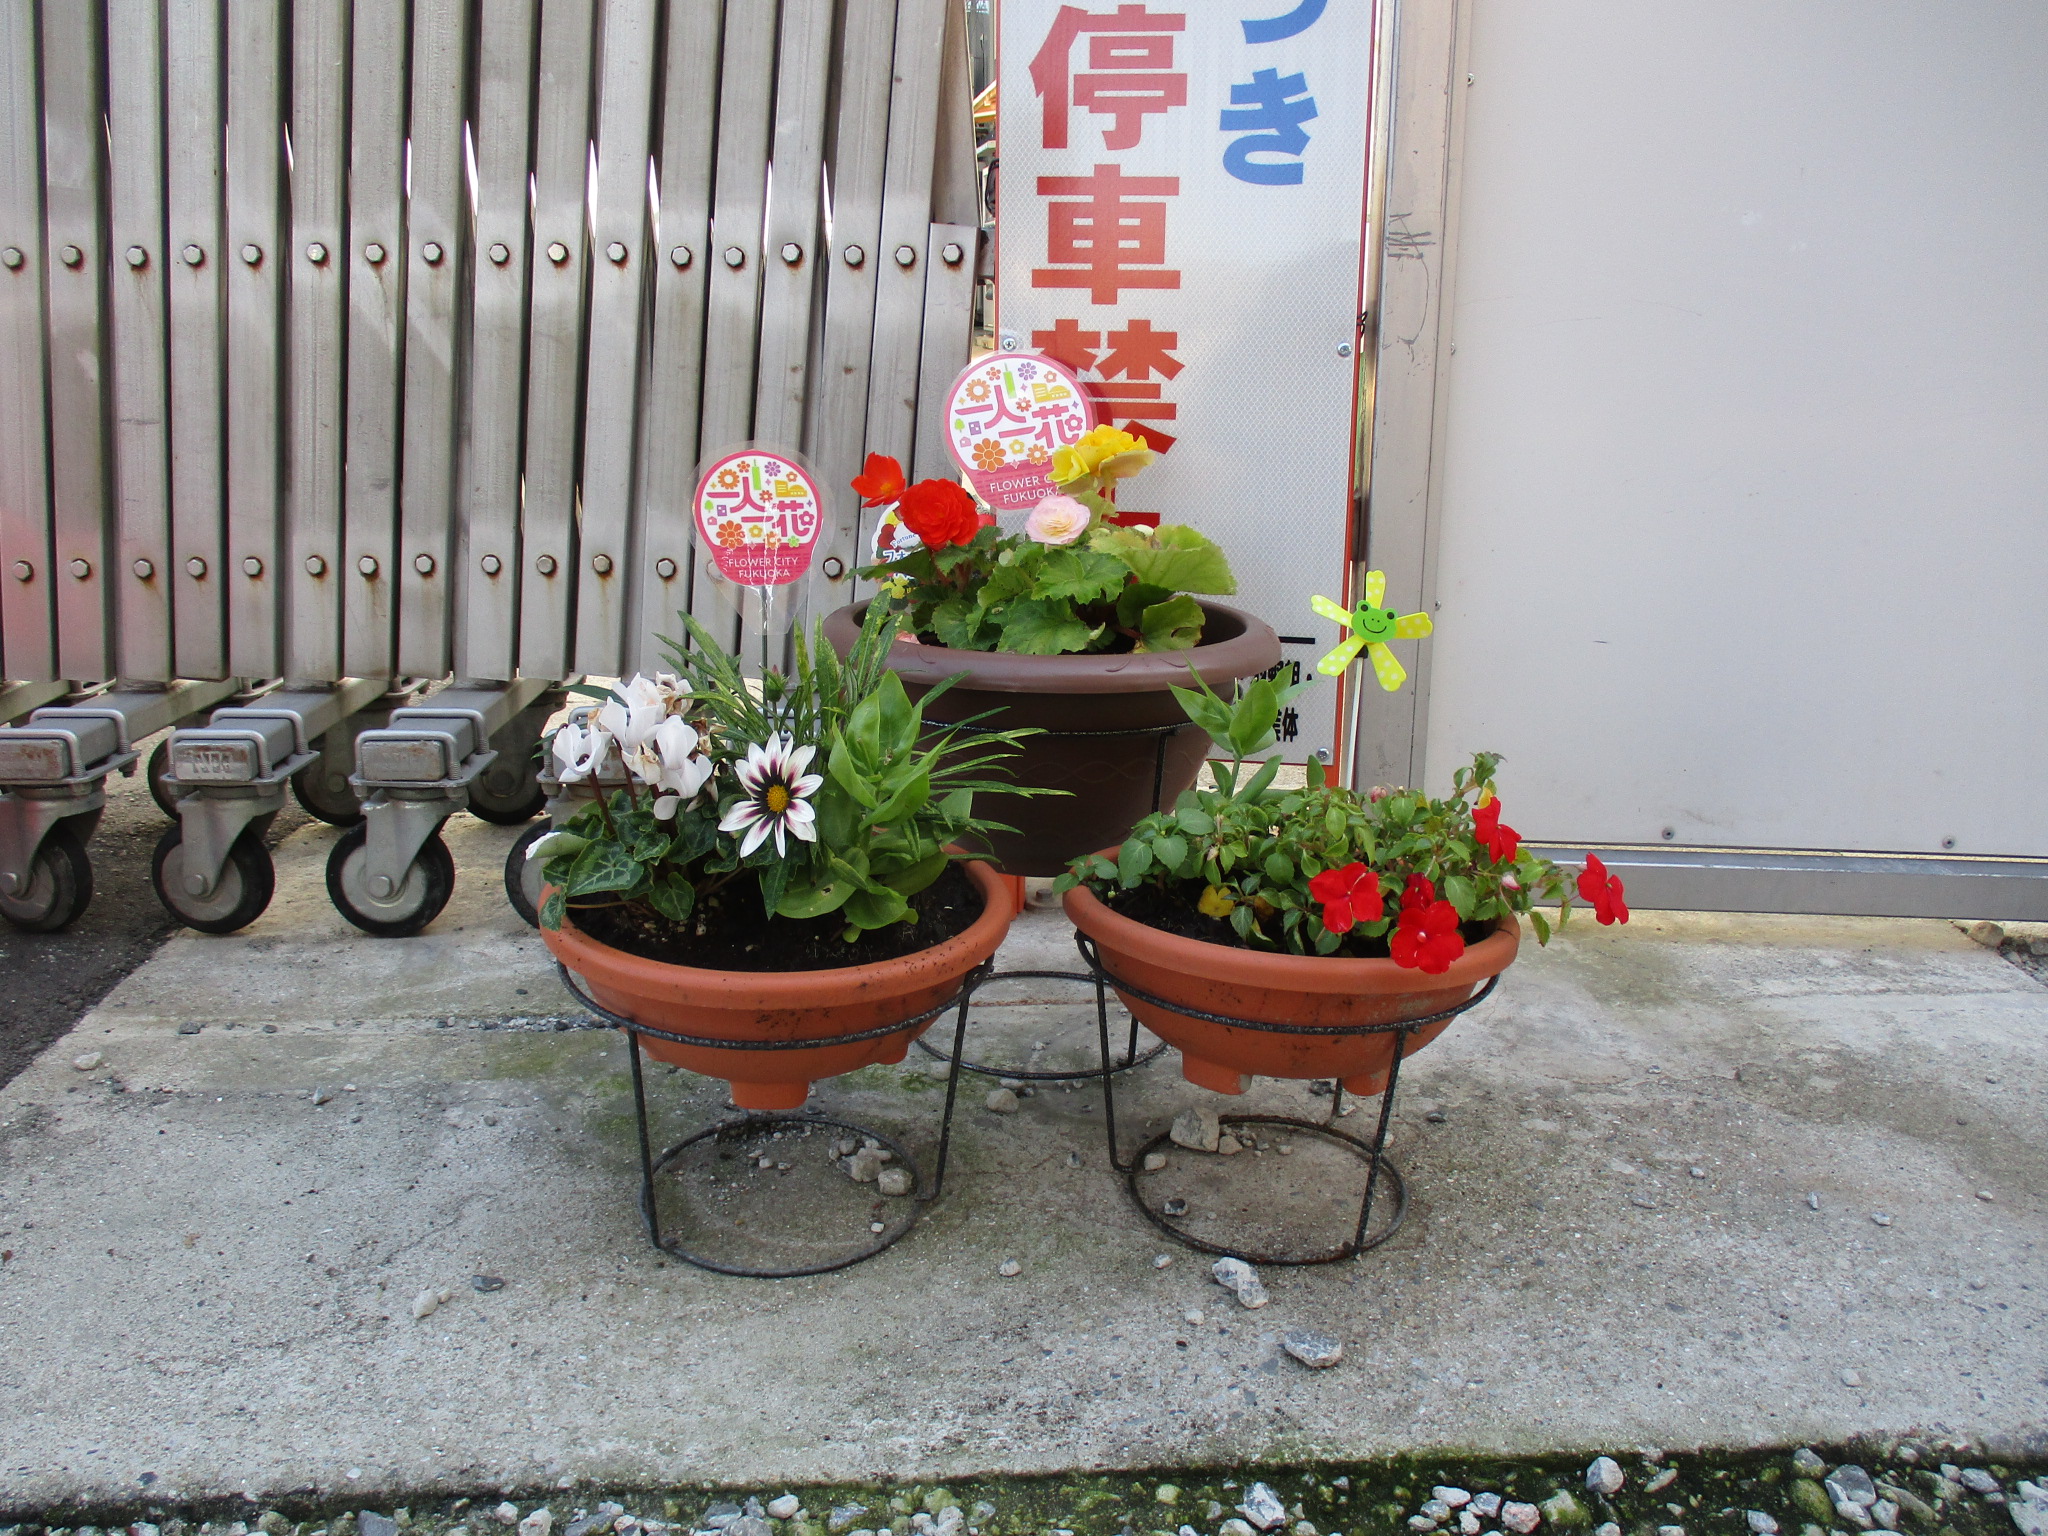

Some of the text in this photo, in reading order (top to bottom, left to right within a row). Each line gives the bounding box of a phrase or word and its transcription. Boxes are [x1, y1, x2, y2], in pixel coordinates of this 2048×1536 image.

[1028, 4, 1188, 528] 停車禁
[990, 475, 1040, 493] FLOWER
[728, 557, 799, 568] FLOWER CITY
[738, 568, 791, 579] FUKUOKA
